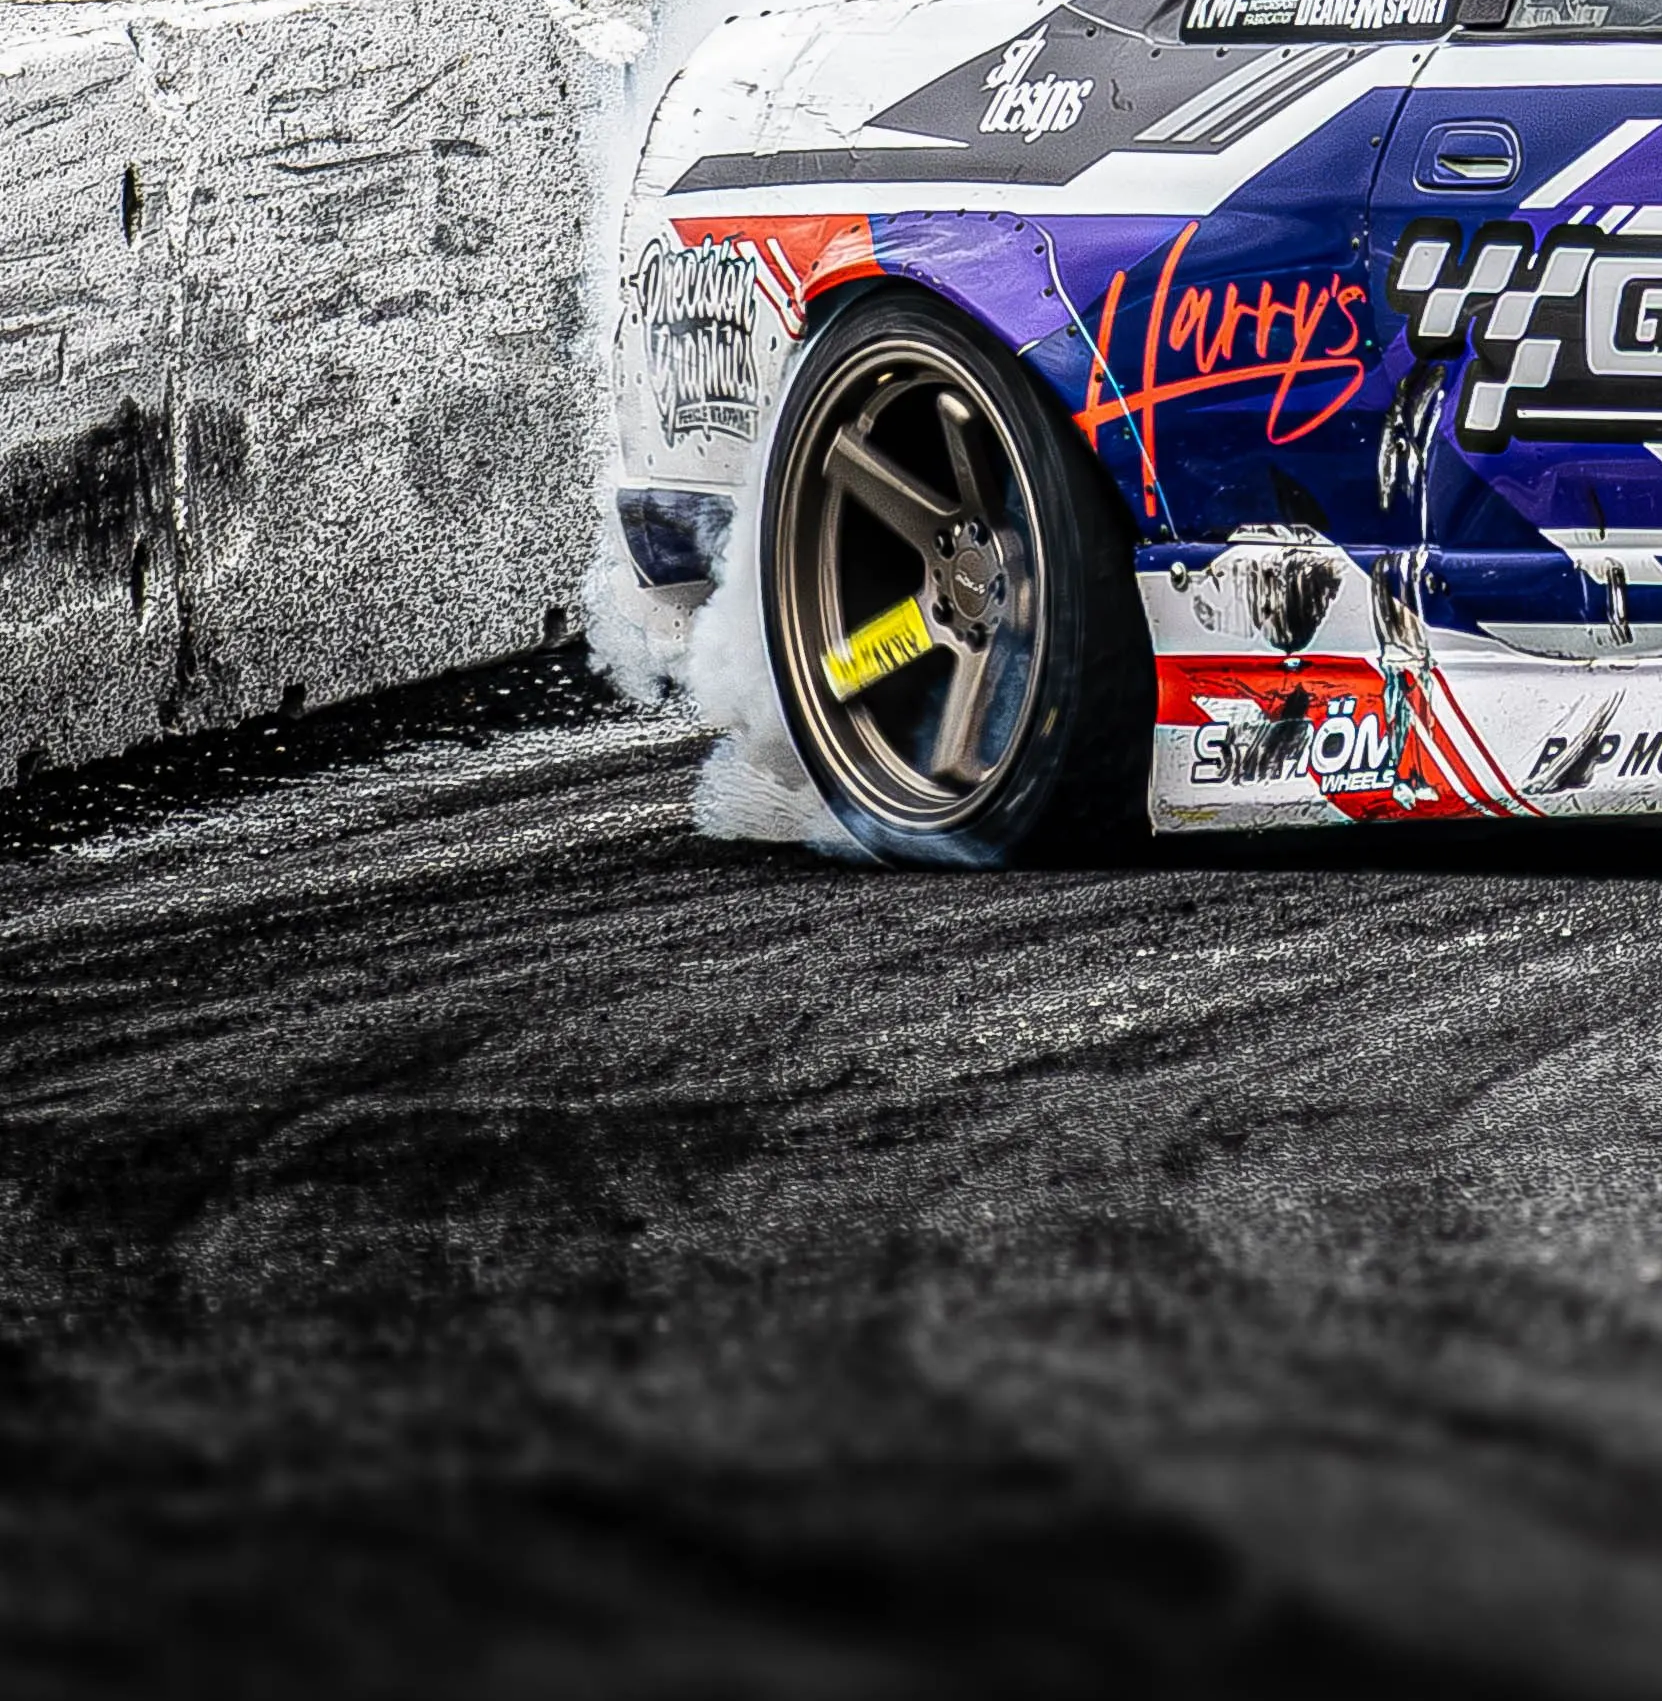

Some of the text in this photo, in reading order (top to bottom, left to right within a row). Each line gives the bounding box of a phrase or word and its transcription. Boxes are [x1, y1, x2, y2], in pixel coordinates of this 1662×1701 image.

[1072, 221, 1366, 517] Harry's
[1191, 698, 1390, 784] SÖM
[1528, 733, 1622, 778] PP
[1321, 772, 1394, 792] WHEELS
